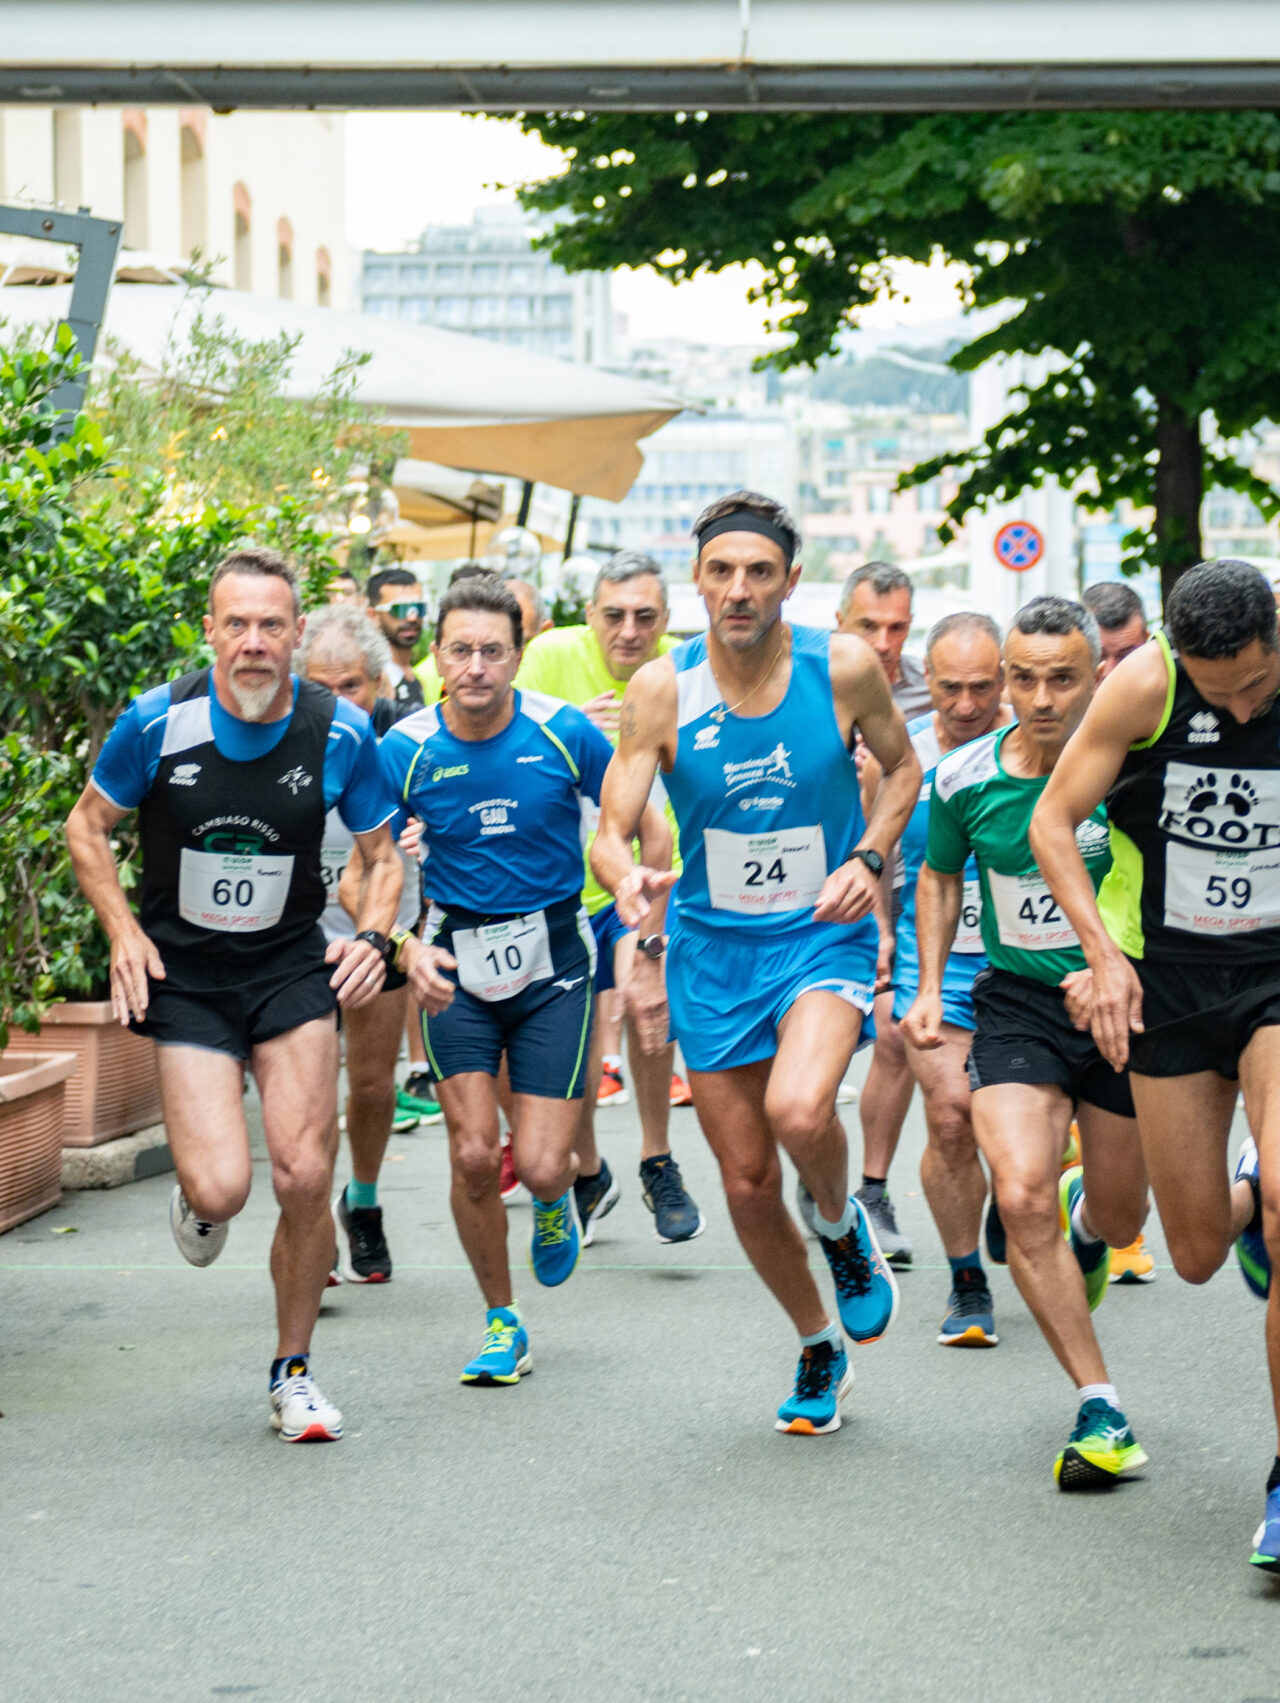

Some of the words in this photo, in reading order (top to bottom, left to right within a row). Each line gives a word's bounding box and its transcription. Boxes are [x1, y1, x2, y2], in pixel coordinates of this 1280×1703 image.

[191, 815, 250, 837] CAMBIASO
[250, 819, 281, 842] RISSO
[744, 858, 787, 887] 24
[212, 879, 254, 907] 60
[1205, 875, 1252, 909] 59
[1019, 895, 1062, 924] 42
[486, 944, 522, 975] 10
